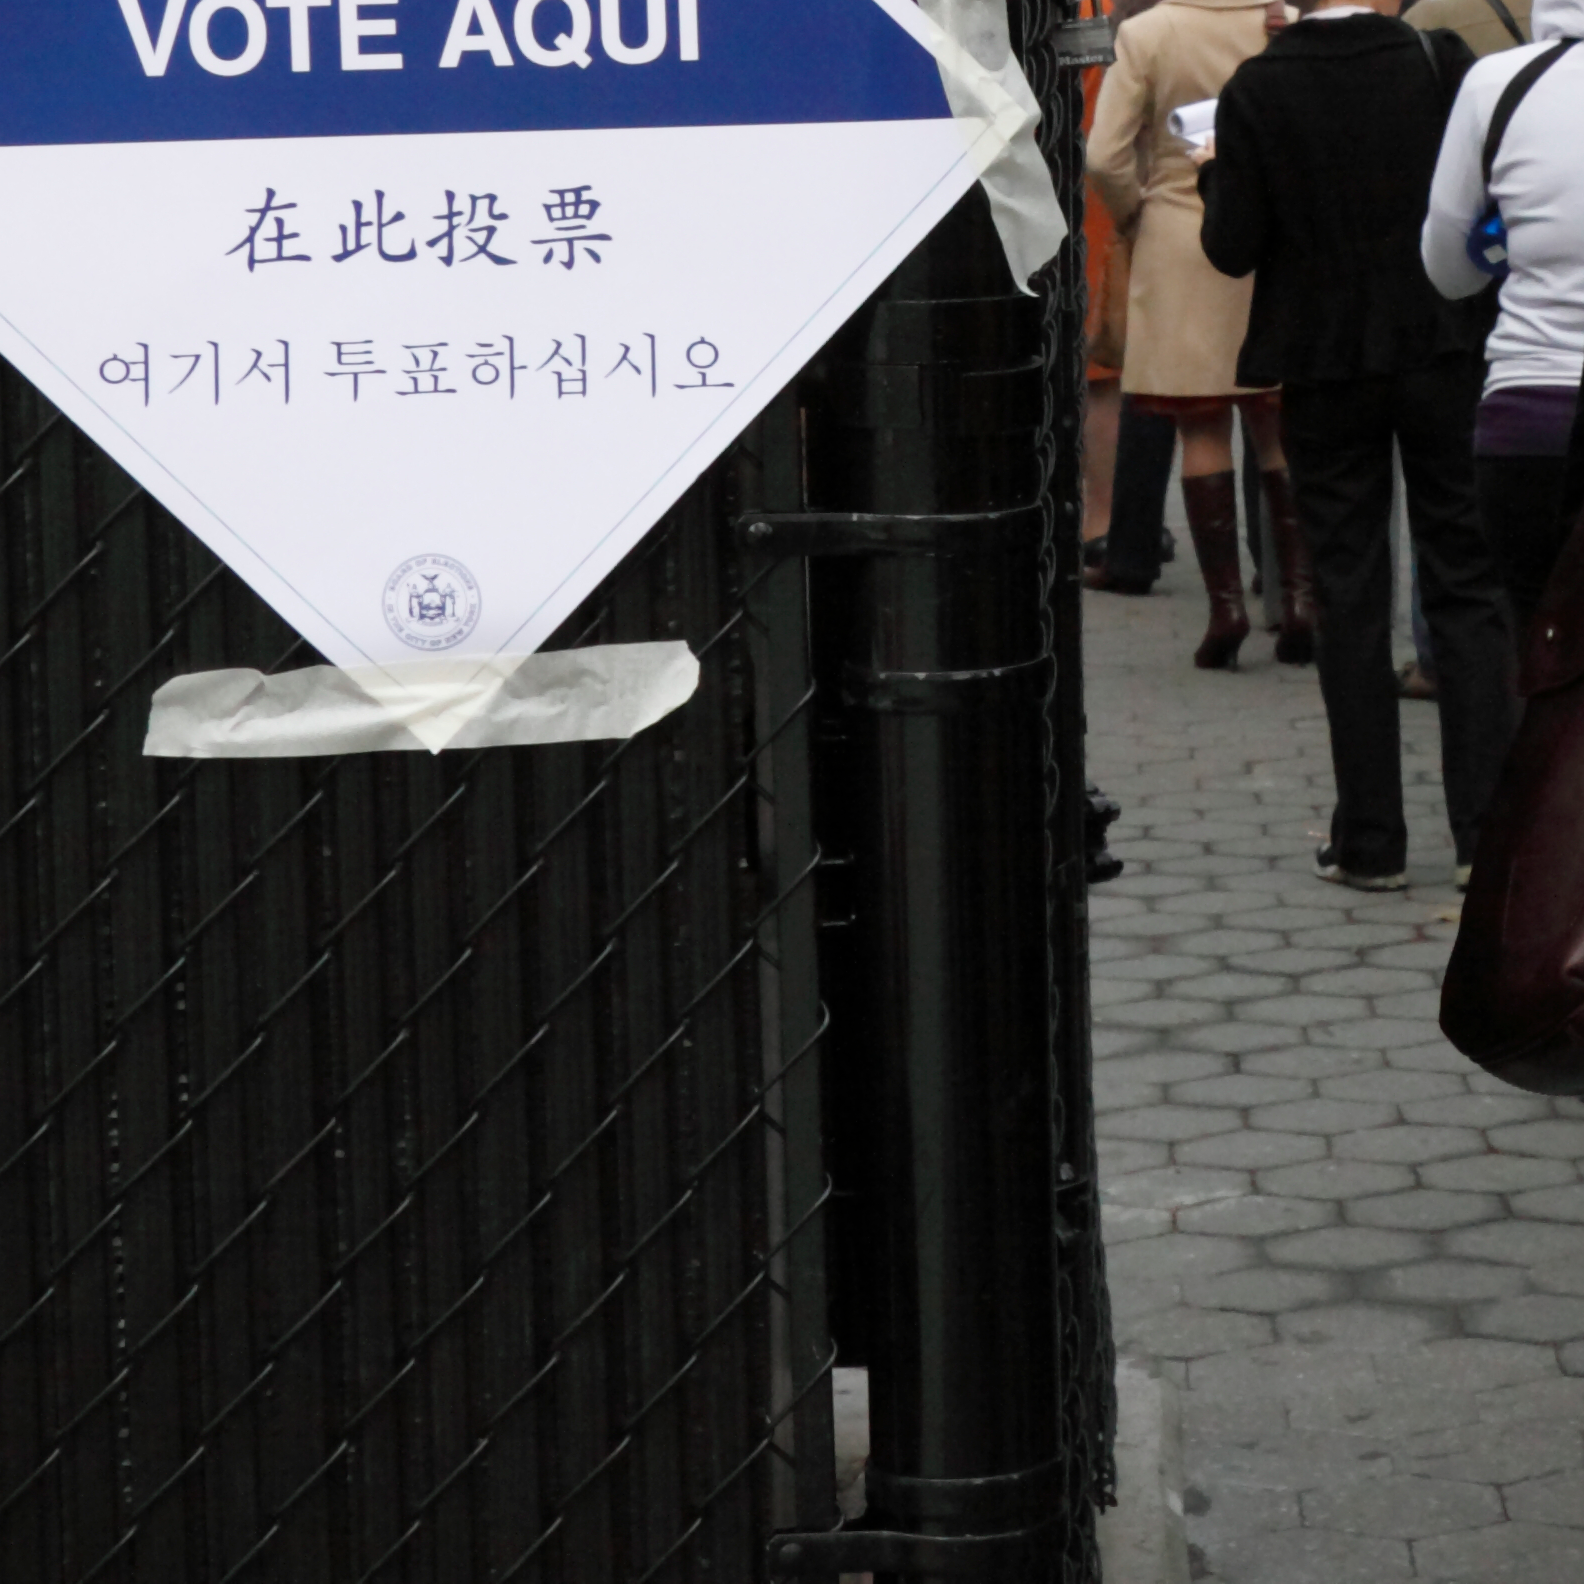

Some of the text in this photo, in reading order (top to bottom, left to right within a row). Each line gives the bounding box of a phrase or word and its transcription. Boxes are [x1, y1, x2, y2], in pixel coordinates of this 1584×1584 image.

[225, 184, 613, 273] 在此投票
[98, 332, 736, 407] 여기서 투표하십시오
